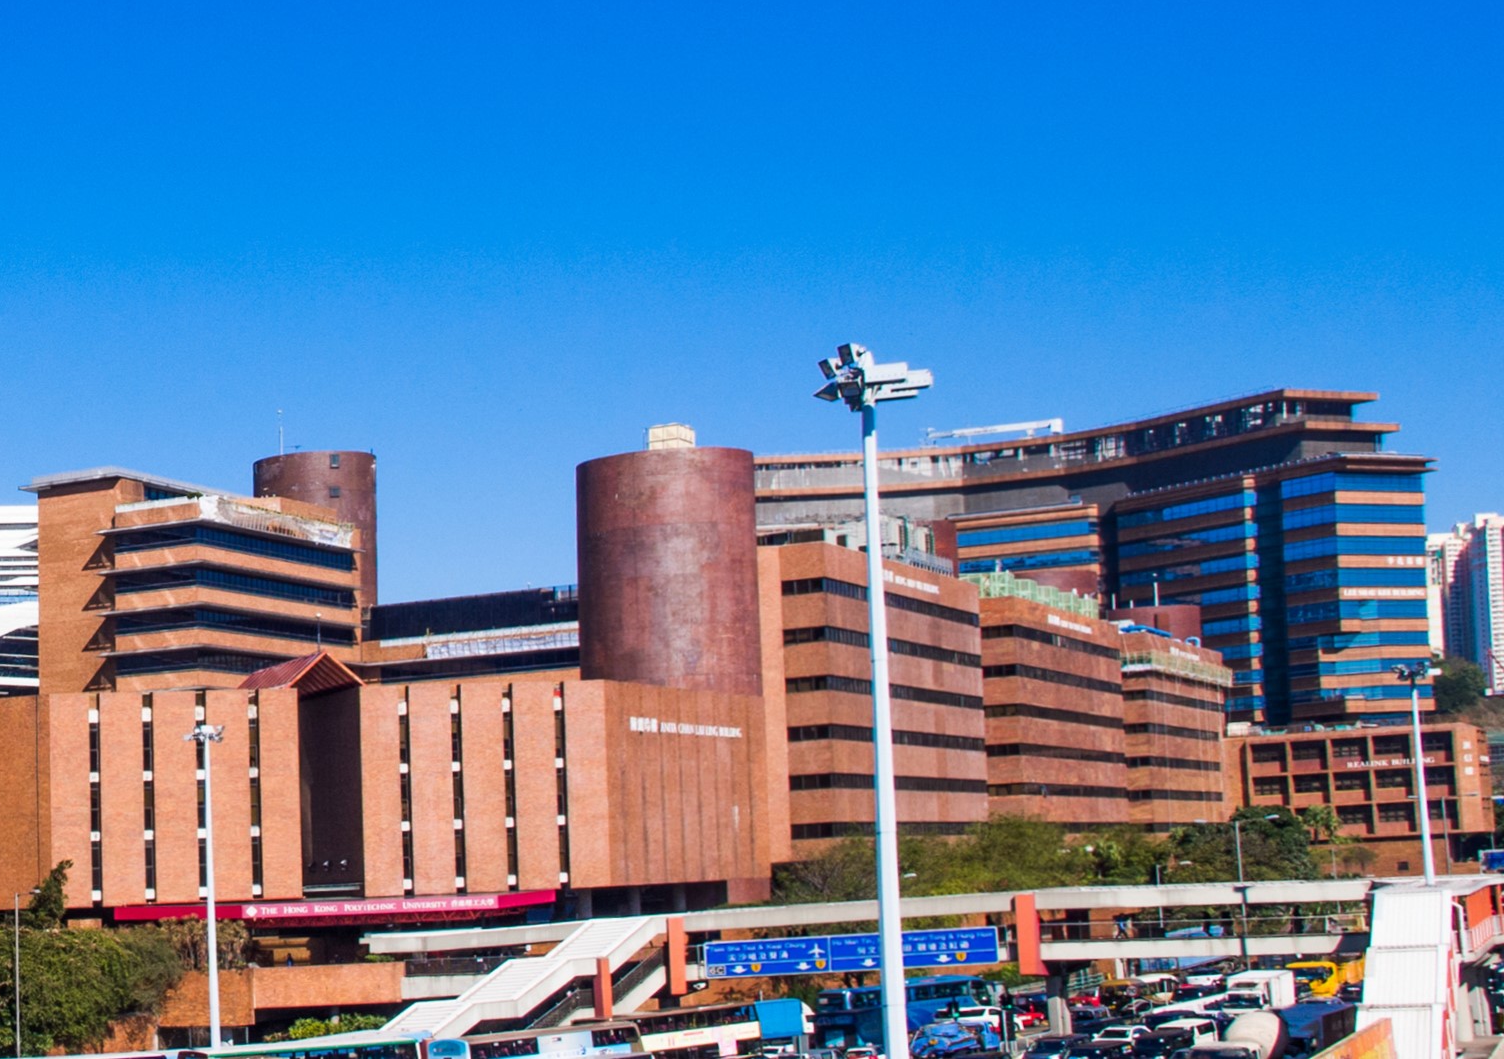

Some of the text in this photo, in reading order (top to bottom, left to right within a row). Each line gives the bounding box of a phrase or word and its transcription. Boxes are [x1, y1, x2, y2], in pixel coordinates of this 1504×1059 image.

[260, 906, 278, 915] THE
[283, 905, 308, 914] HONG
[314, 904, 338, 913] KONG
[402, 901, 447, 909] UNIVERSITY
